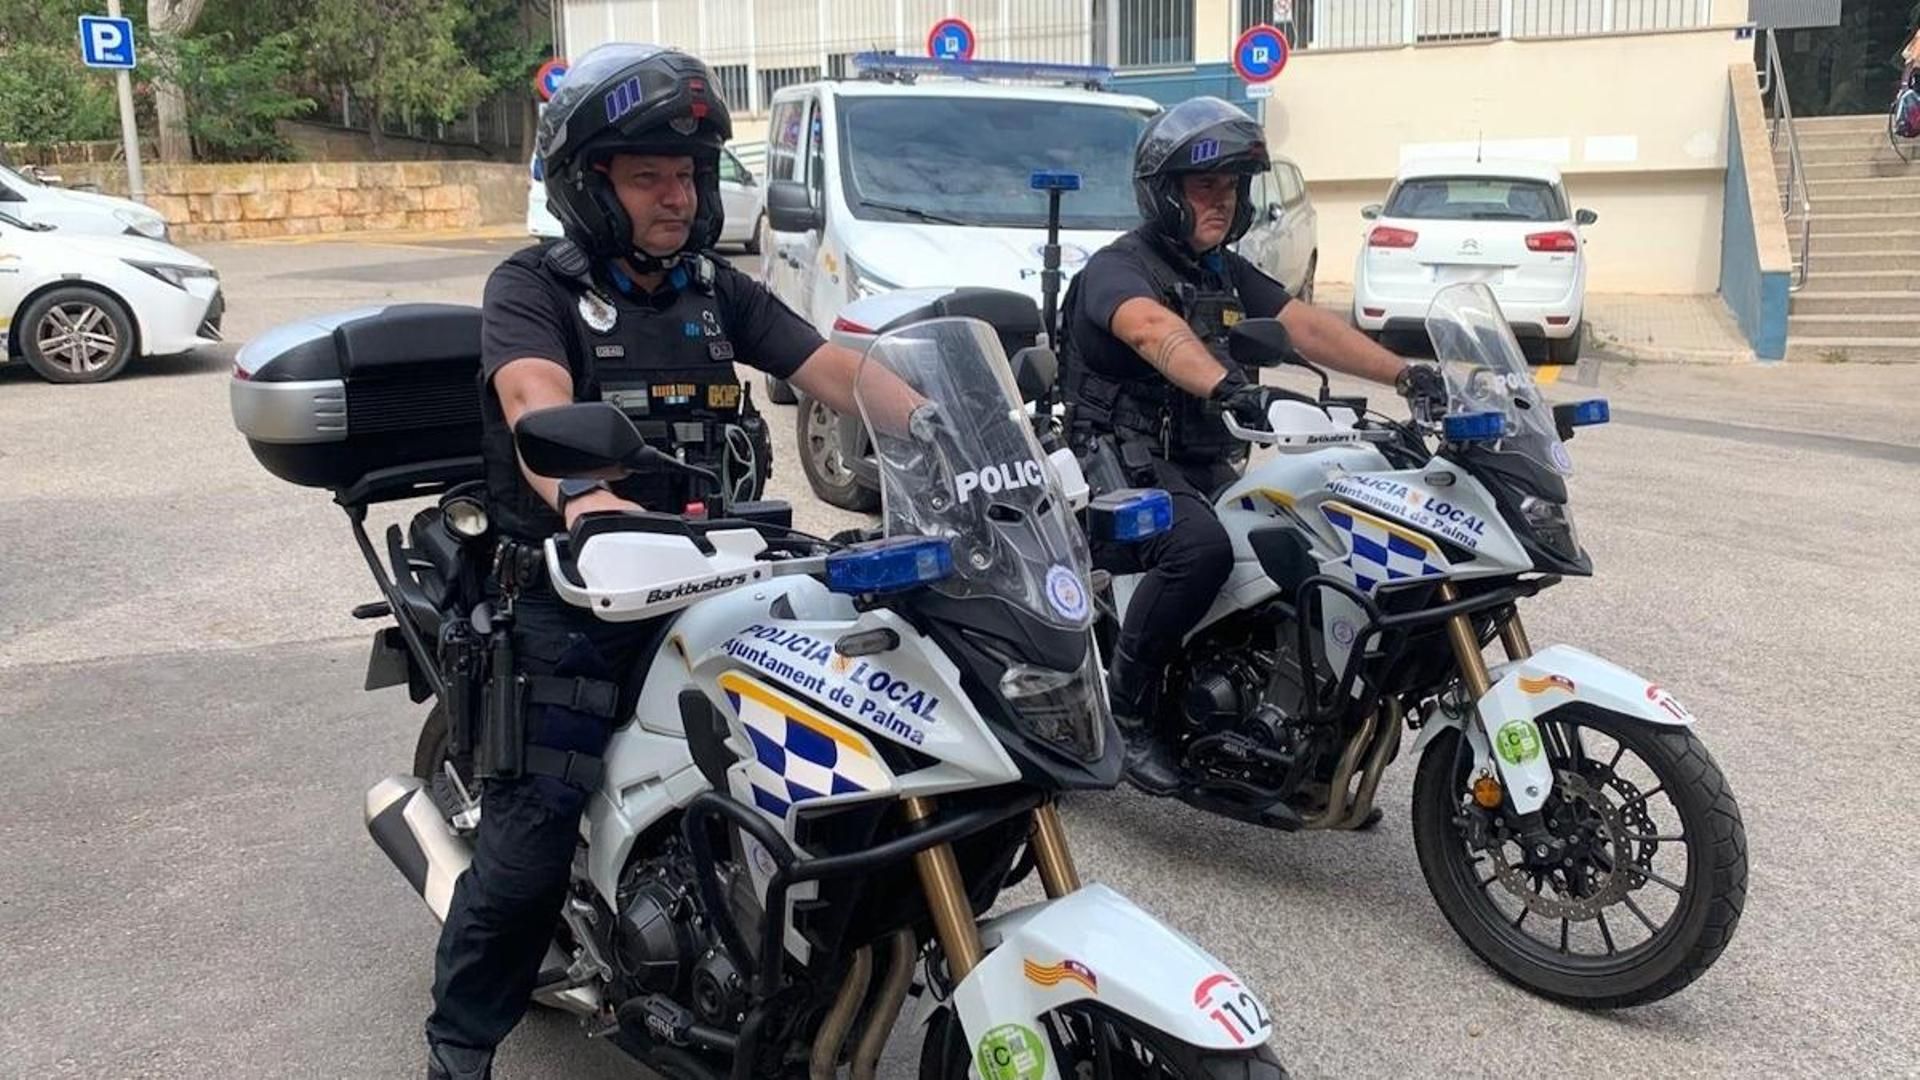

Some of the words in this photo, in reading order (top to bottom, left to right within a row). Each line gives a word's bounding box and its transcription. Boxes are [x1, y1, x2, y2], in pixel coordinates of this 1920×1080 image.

[91, 22, 122, 60] P
[1324, 481, 1408, 517] Ajuntament
[1431, 518, 1478, 549] Palma
[1424, 497, 1485, 536] LOCAL
[646, 573, 748, 604] Barkbusters
[720, 637, 827, 695] Ajuntament
[829, 685, 855, 708] de
[858, 697, 925, 746] Palma
[739, 624, 833, 666] POLICIA
[849, 661, 940, 724] LOCAL
[1507, 731, 1521, 746] C
[1210, 991, 1273, 1045] 112
[993, 1046, 1011, 1067] C
